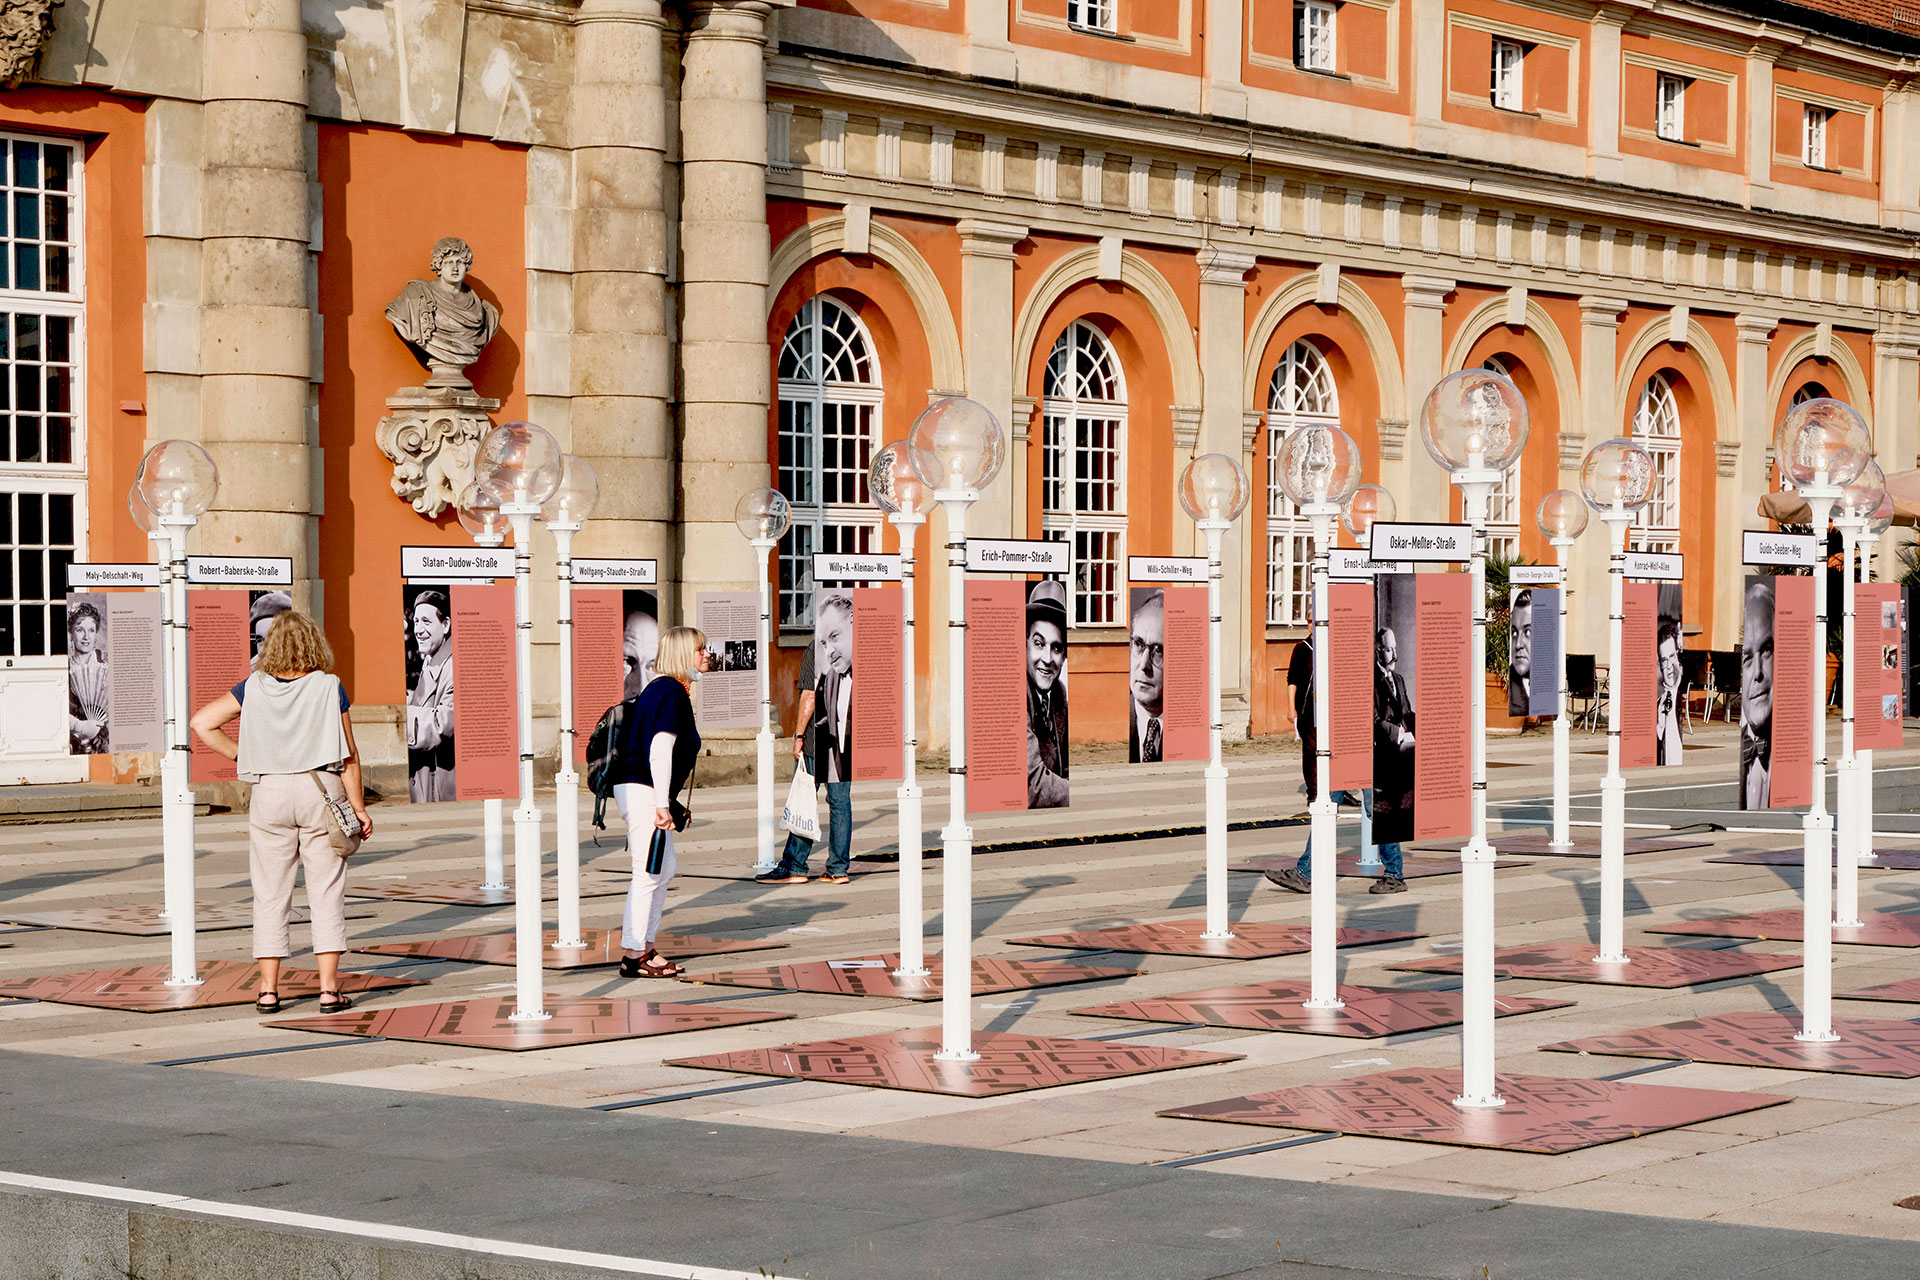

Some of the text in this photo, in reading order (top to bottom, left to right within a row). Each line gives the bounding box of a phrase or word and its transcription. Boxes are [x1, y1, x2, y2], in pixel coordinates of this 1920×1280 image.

[1389, 535, 1457, 550] Oskar-Meßter-Straße
[422, 556, 498, 568] Slatan-Dudow-Straße
[981, 549, 1053, 563] Erich-Pommer-Straße
[199, 564, 279, 577] Robert-Baberske-Straße
[578, 566, 647, 578] Wolfgang-Staudte-Straße
[828, 561, 889, 575] Willy-A.-Kleinau-Weg
[1146, 564, 1193, 577] Willi-Schiller-Weg
[85, 570, 144, 582] Maly-Delschaft-Weg
